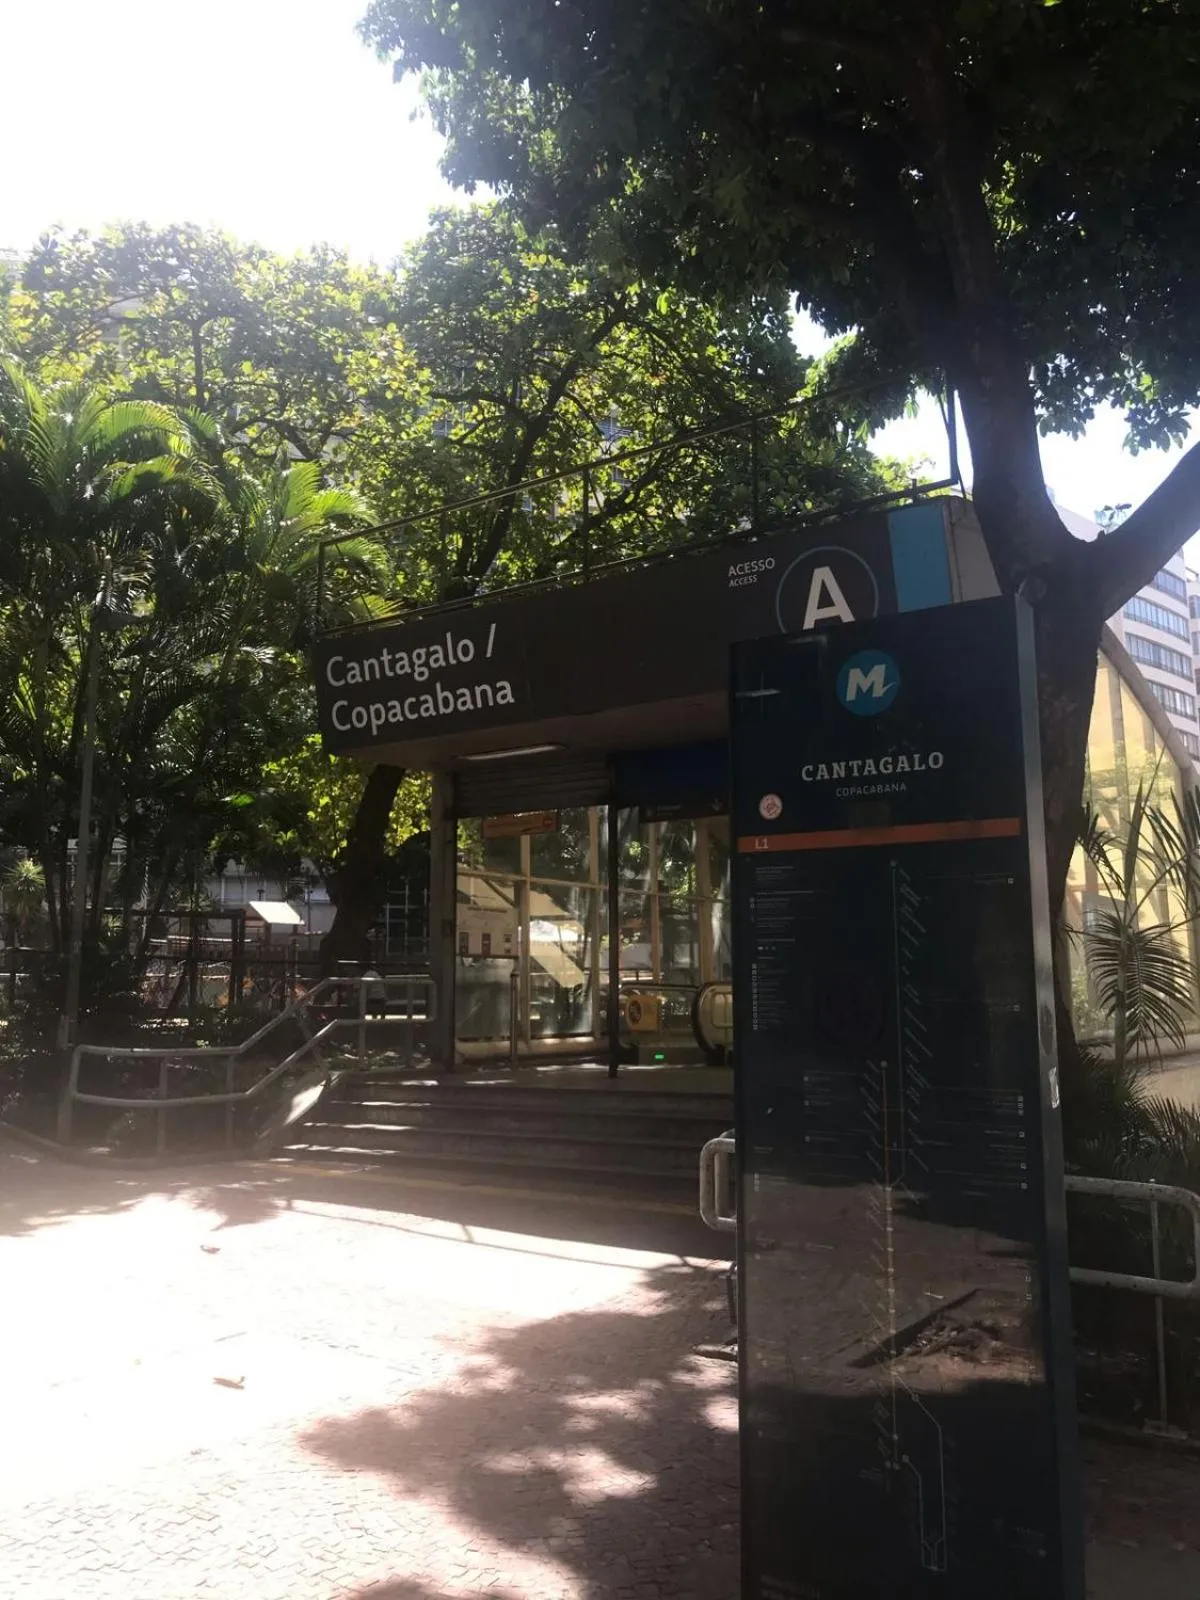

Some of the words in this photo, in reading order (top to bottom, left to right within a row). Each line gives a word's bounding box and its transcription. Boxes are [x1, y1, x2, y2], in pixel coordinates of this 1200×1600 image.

[728, 557, 775, 577] ACESSO
[728, 574, 758, 588] ACCESS
[803, 566, 856, 630] A
[326, 632, 475, 687] Cantagalo
[485, 623, 497, 658] /
[331, 680, 515, 736] Copacabana
[800, 751, 945, 782] CANTAGALO
[835, 782, 908, 798] COPACABANA
